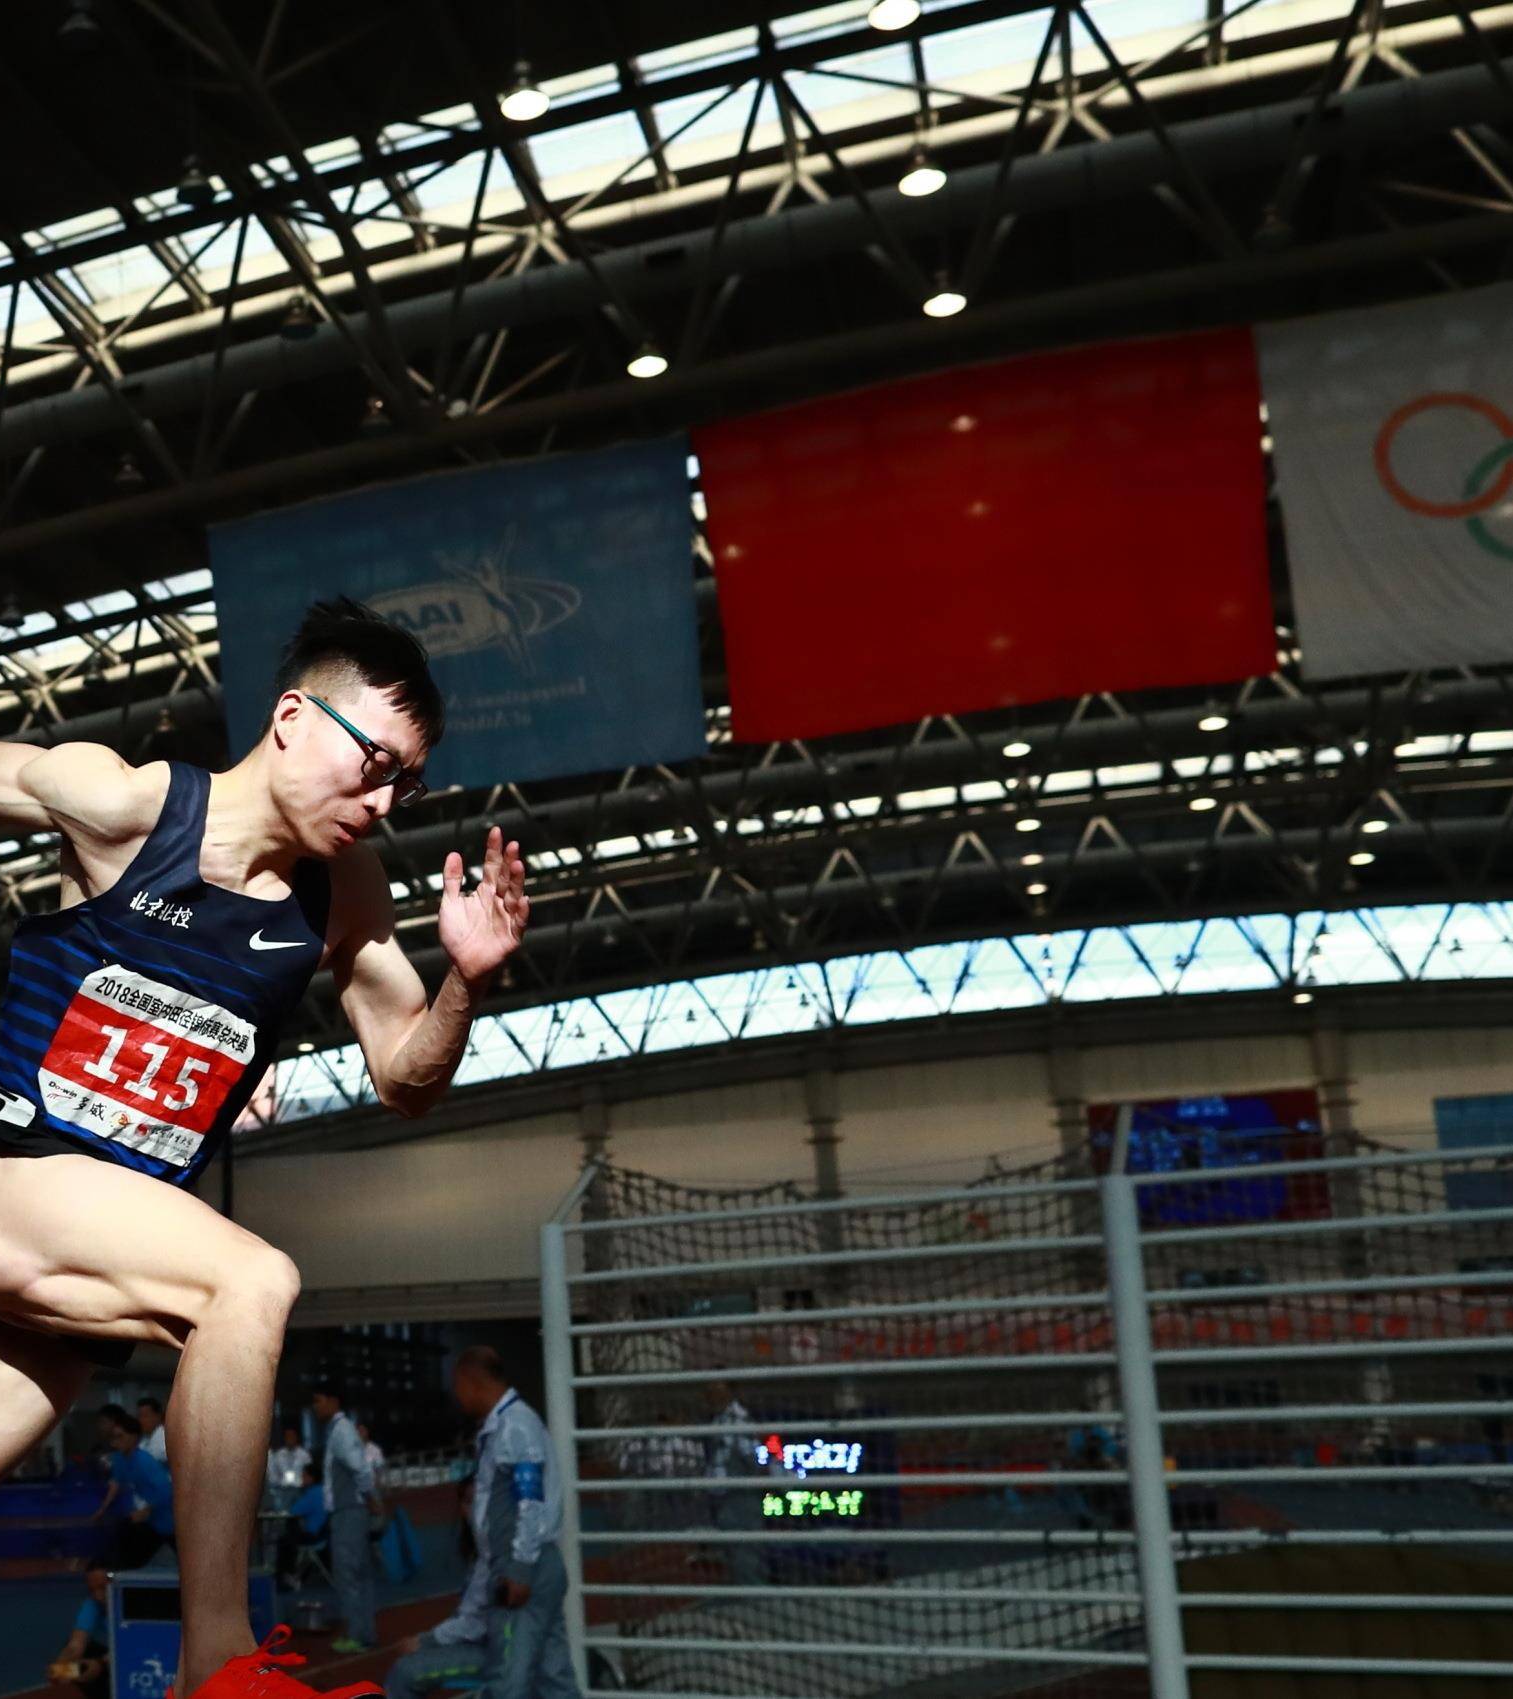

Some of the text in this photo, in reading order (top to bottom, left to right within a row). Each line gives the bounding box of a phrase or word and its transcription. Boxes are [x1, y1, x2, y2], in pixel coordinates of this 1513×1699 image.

[95, 977, 249, 1053] 2018全国室内田径锦标赛总决赛
[48, 1081, 78, 1098] Do-win
[83, 1025, 210, 1112] 115
[73, 1096, 107, 1121] 多威
